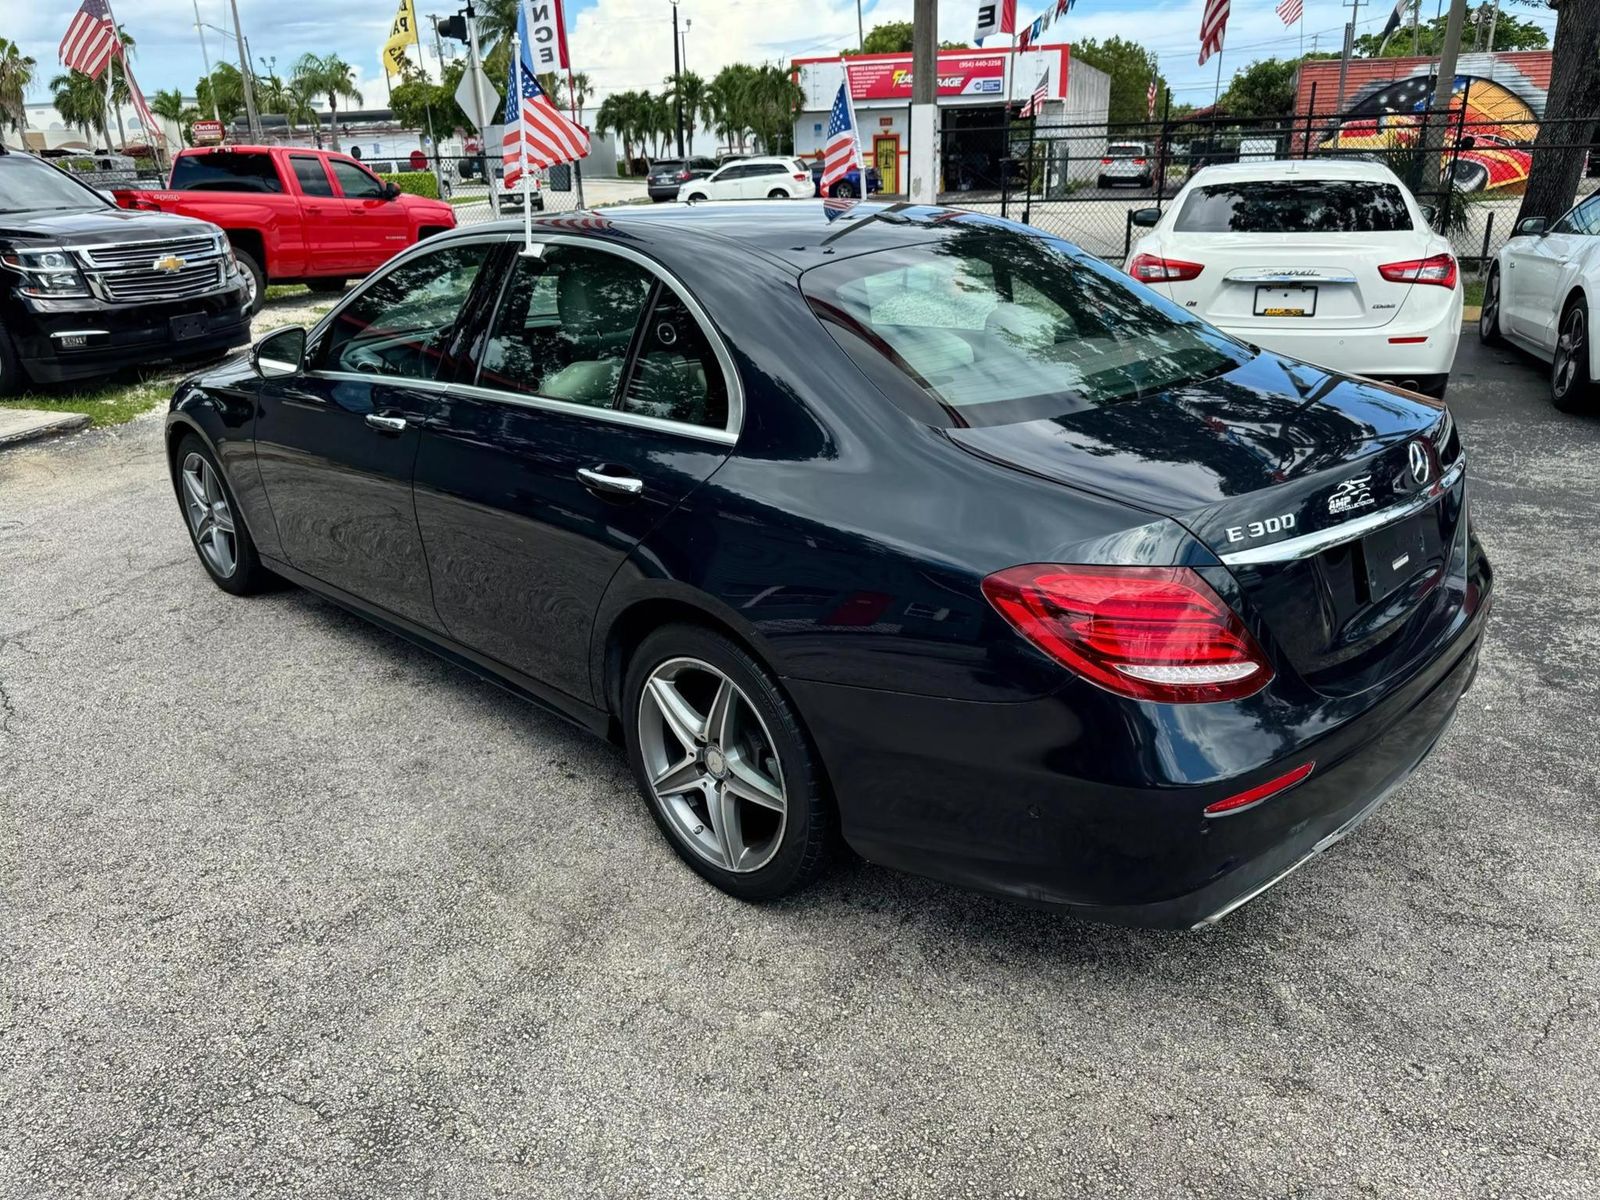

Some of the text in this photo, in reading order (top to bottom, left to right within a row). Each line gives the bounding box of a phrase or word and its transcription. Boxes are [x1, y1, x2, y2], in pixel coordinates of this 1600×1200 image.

[1329, 496, 1351, 510] AMP
[1226, 514, 1295, 543] E 300
